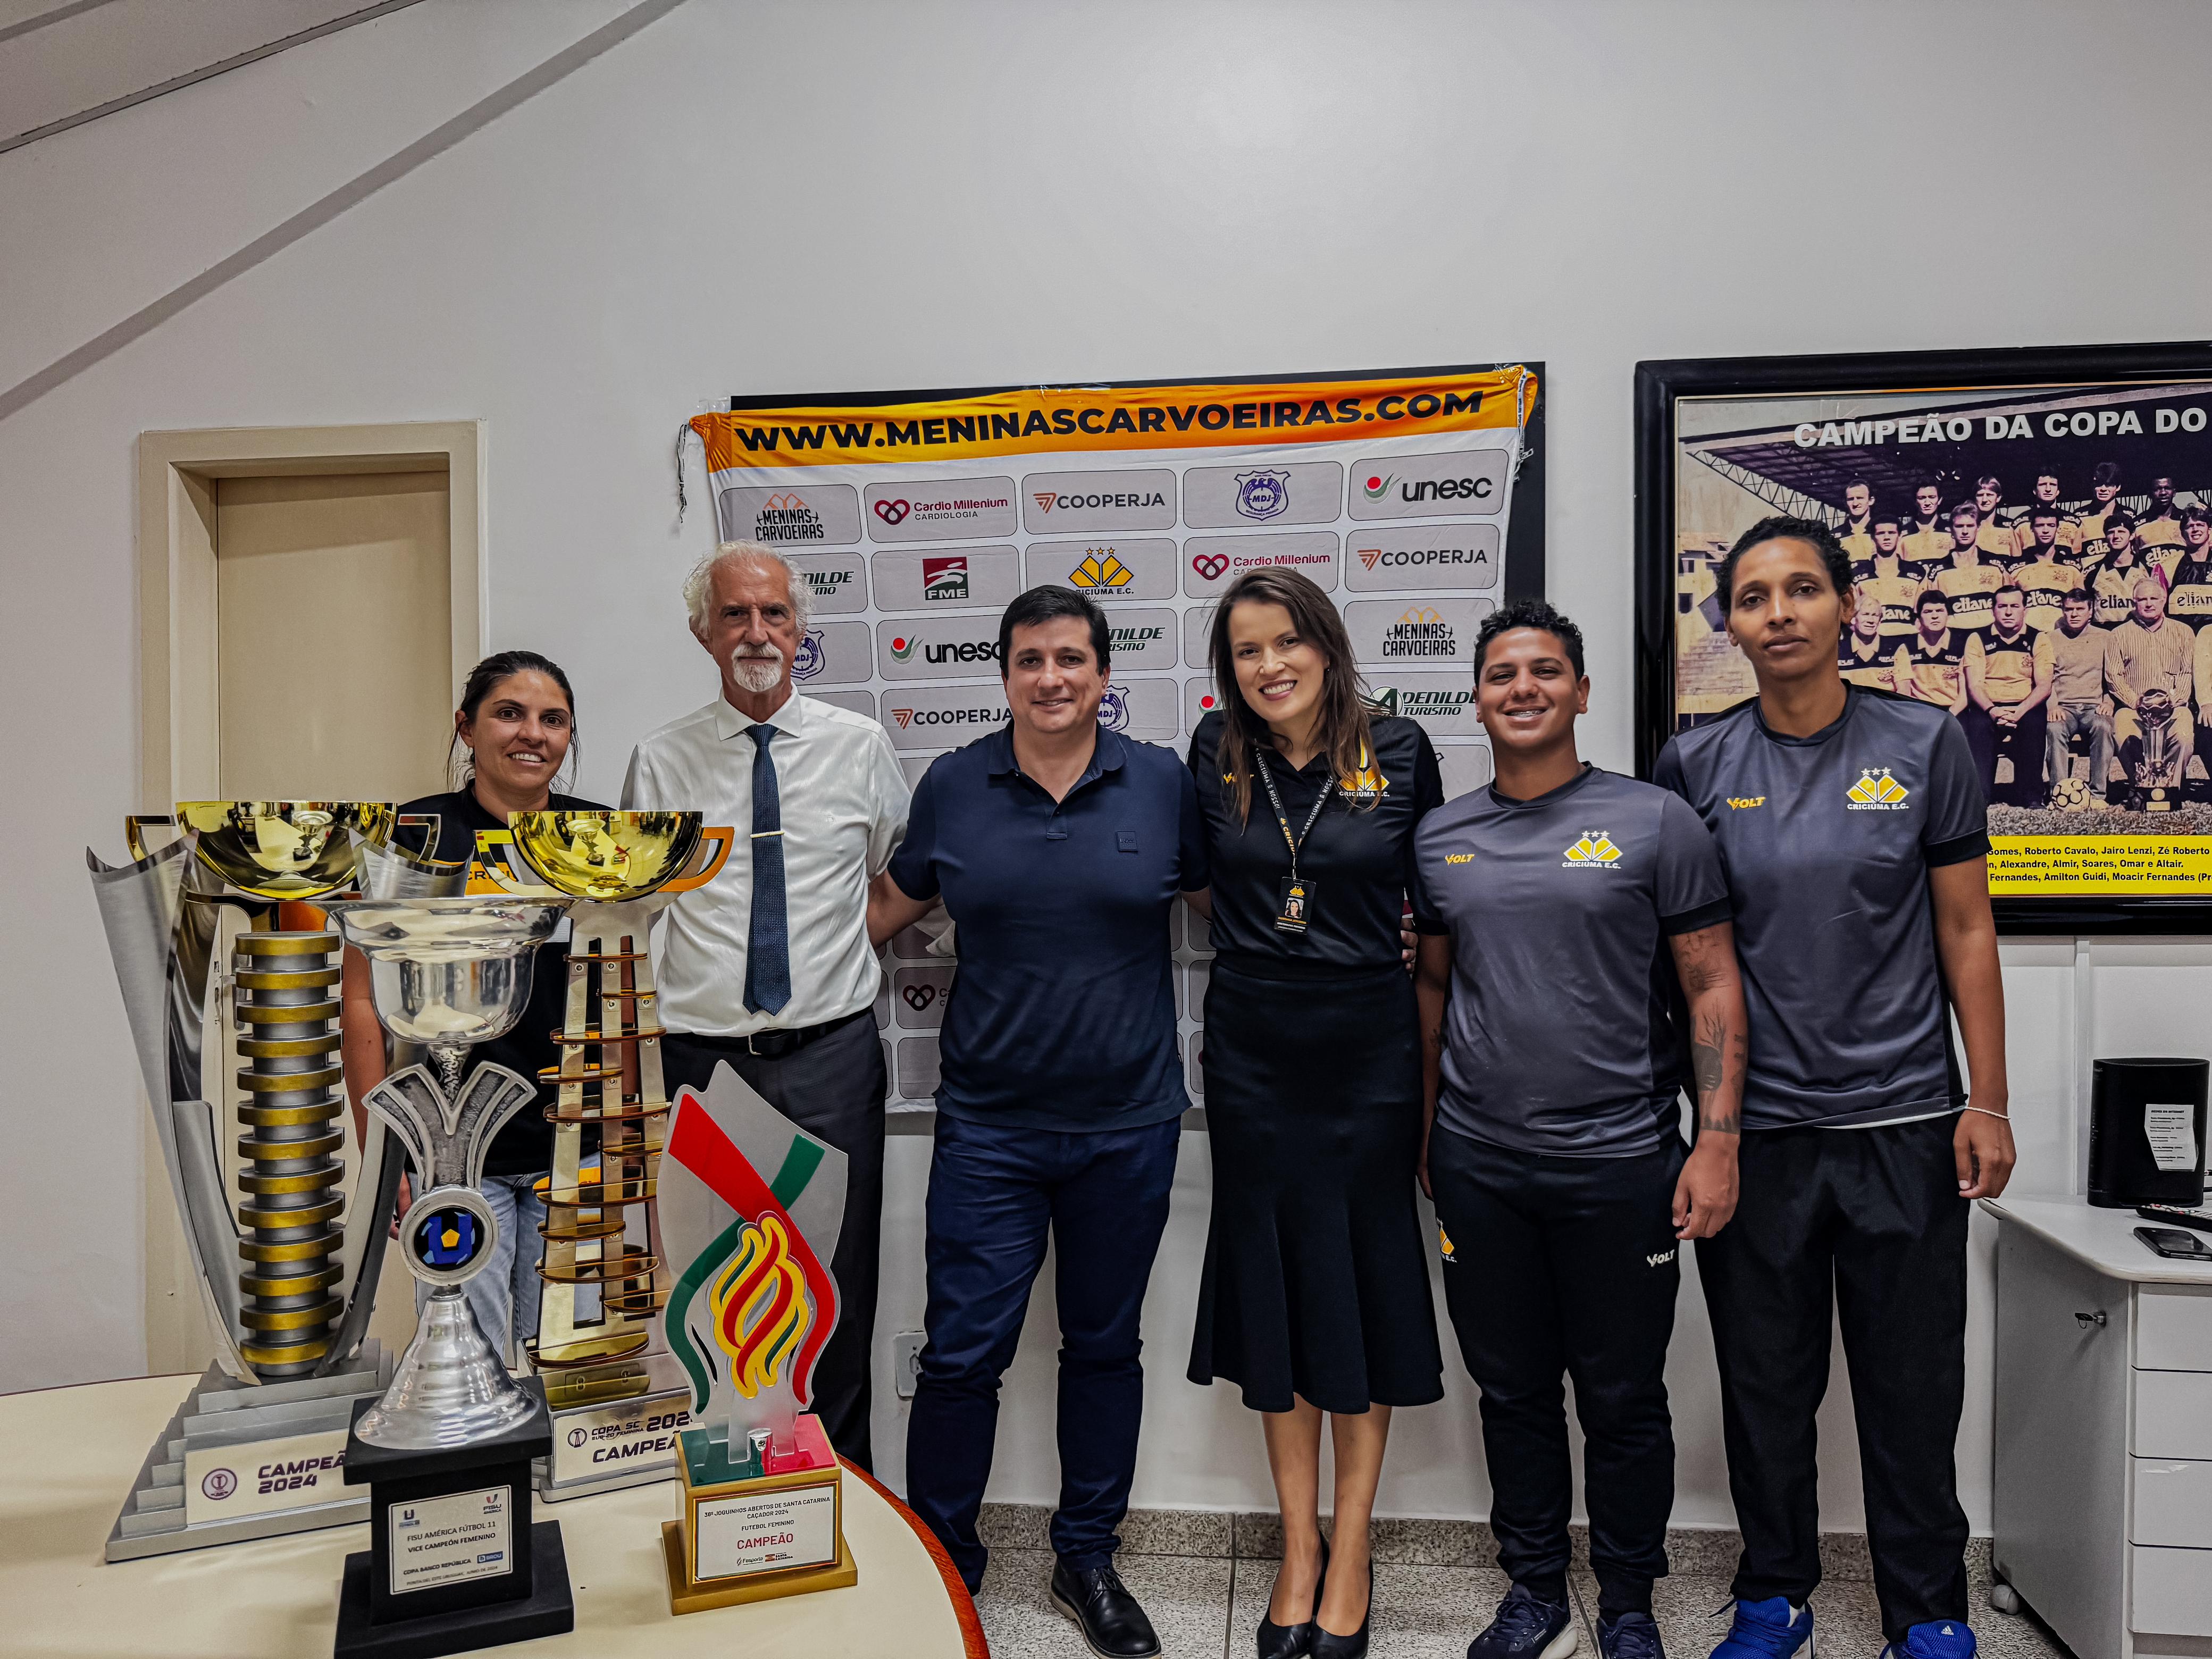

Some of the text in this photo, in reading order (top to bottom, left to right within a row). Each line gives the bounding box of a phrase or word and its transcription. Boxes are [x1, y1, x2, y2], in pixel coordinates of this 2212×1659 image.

[735, 391, 1484, 451] WWW.MENINASCARVOEIRAS.COM
[1794, 408, 2207, 448] CAMPEÃO DA COPA DO
[1402, 477, 1493, 502] unesc
[914, 498, 1008, 511] Cardio Millenium
[1057, 492, 1166, 509] COOPERJA
[763, 509, 812, 525] MENINAS
[915, 511, 978, 520] CARDIOLOGIA
[755, 524, 824, 541] CARVOEIRAS
[1233, 554, 1330, 566] Cardio Millenium
[1381, 549, 1487, 566] COOPERJA
[928, 589, 967, 599] FME
[1394, 623, 1446, 639] MENINAS
[1383, 640, 1455, 656] CARVOEIRAS
[914, 708, 1013, 725] COOPERJA
[1404, 707, 1461, 715] TURISMO
[1727, 797, 1765, 810] VOLT
[1445, 853, 1474, 865] VOLT
[2064, 847, 2098, 856] Cavalo,
[2128, 847, 2155, 856] Lenzi,
[2000, 860, 2050, 869] Alexandre,
[2052, 860, 2079, 869] Almir,
[2082, 860, 2117, 869] Soares,
[1990, 874, 2041, 883] Fernandes,
[2082, 873, 2109, 882] Guidi,
[1647, 1249, 1675, 1267] VOLT
[591, 1411, 693, 1435] COPA SC 202
[258, 1473, 317, 1494] 2024
[424, 1528, 457, 1539] AMÉRICA
[459, 1523, 486, 1533] FÚTBOL
[460, 1532, 496, 1544] FEMENINO
[737, 1532, 793, 1549] CAMPEÃO
